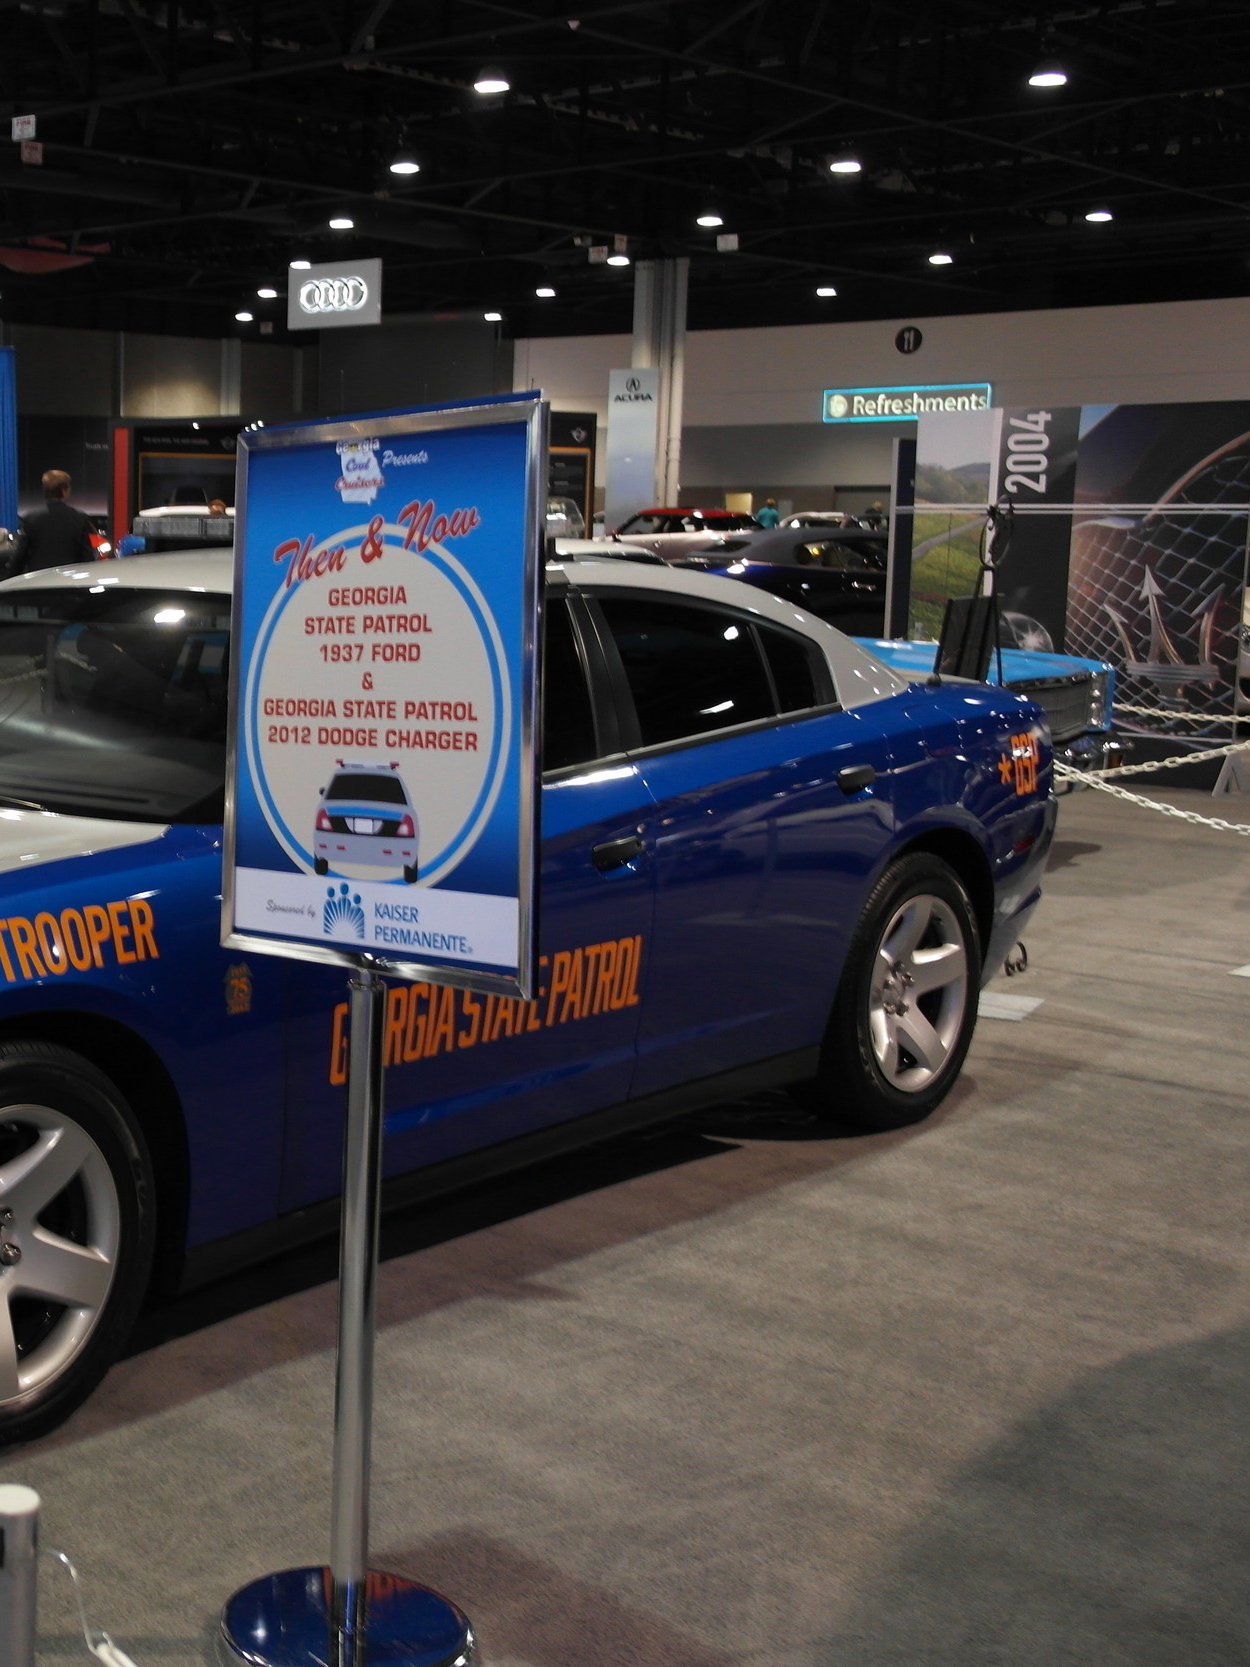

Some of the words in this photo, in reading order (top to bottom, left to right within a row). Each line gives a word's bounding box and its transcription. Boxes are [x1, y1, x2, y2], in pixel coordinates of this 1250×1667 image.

[614, 393, 652, 402] ACURA
[853, 392, 986, 416] Refreshments
[382, 450, 428, 467] Presents
[1005, 410, 1051, 494] 2004
[346, 458, 370, 472] Cool
[335, 476, 385, 491] Cruisers
[274, 533, 347, 589] Then
[360, 515, 384, 564] &
[397, 499, 480, 553] Now
[327, 585, 407, 606] GEORGIA
[304, 616, 356, 635] STATE
[362, 614, 432, 633] PATROL
[319, 643, 365, 663] 1937
[371, 644, 421, 662] FORD
[361, 671, 374, 690] &
[263, 698, 337, 718] GEORGIA
[343, 699, 397, 719] STATE
[404, 701, 478, 721] PATROL
[268, 725, 311, 745] 2012
[317, 727, 378, 747] DODGE
[384, 730, 478, 751] CHARGER
[374, 902, 419, 924] KAISER
[330, 982, 455, 1086] GRGIA
[545, 935, 642, 1027] PATROL
